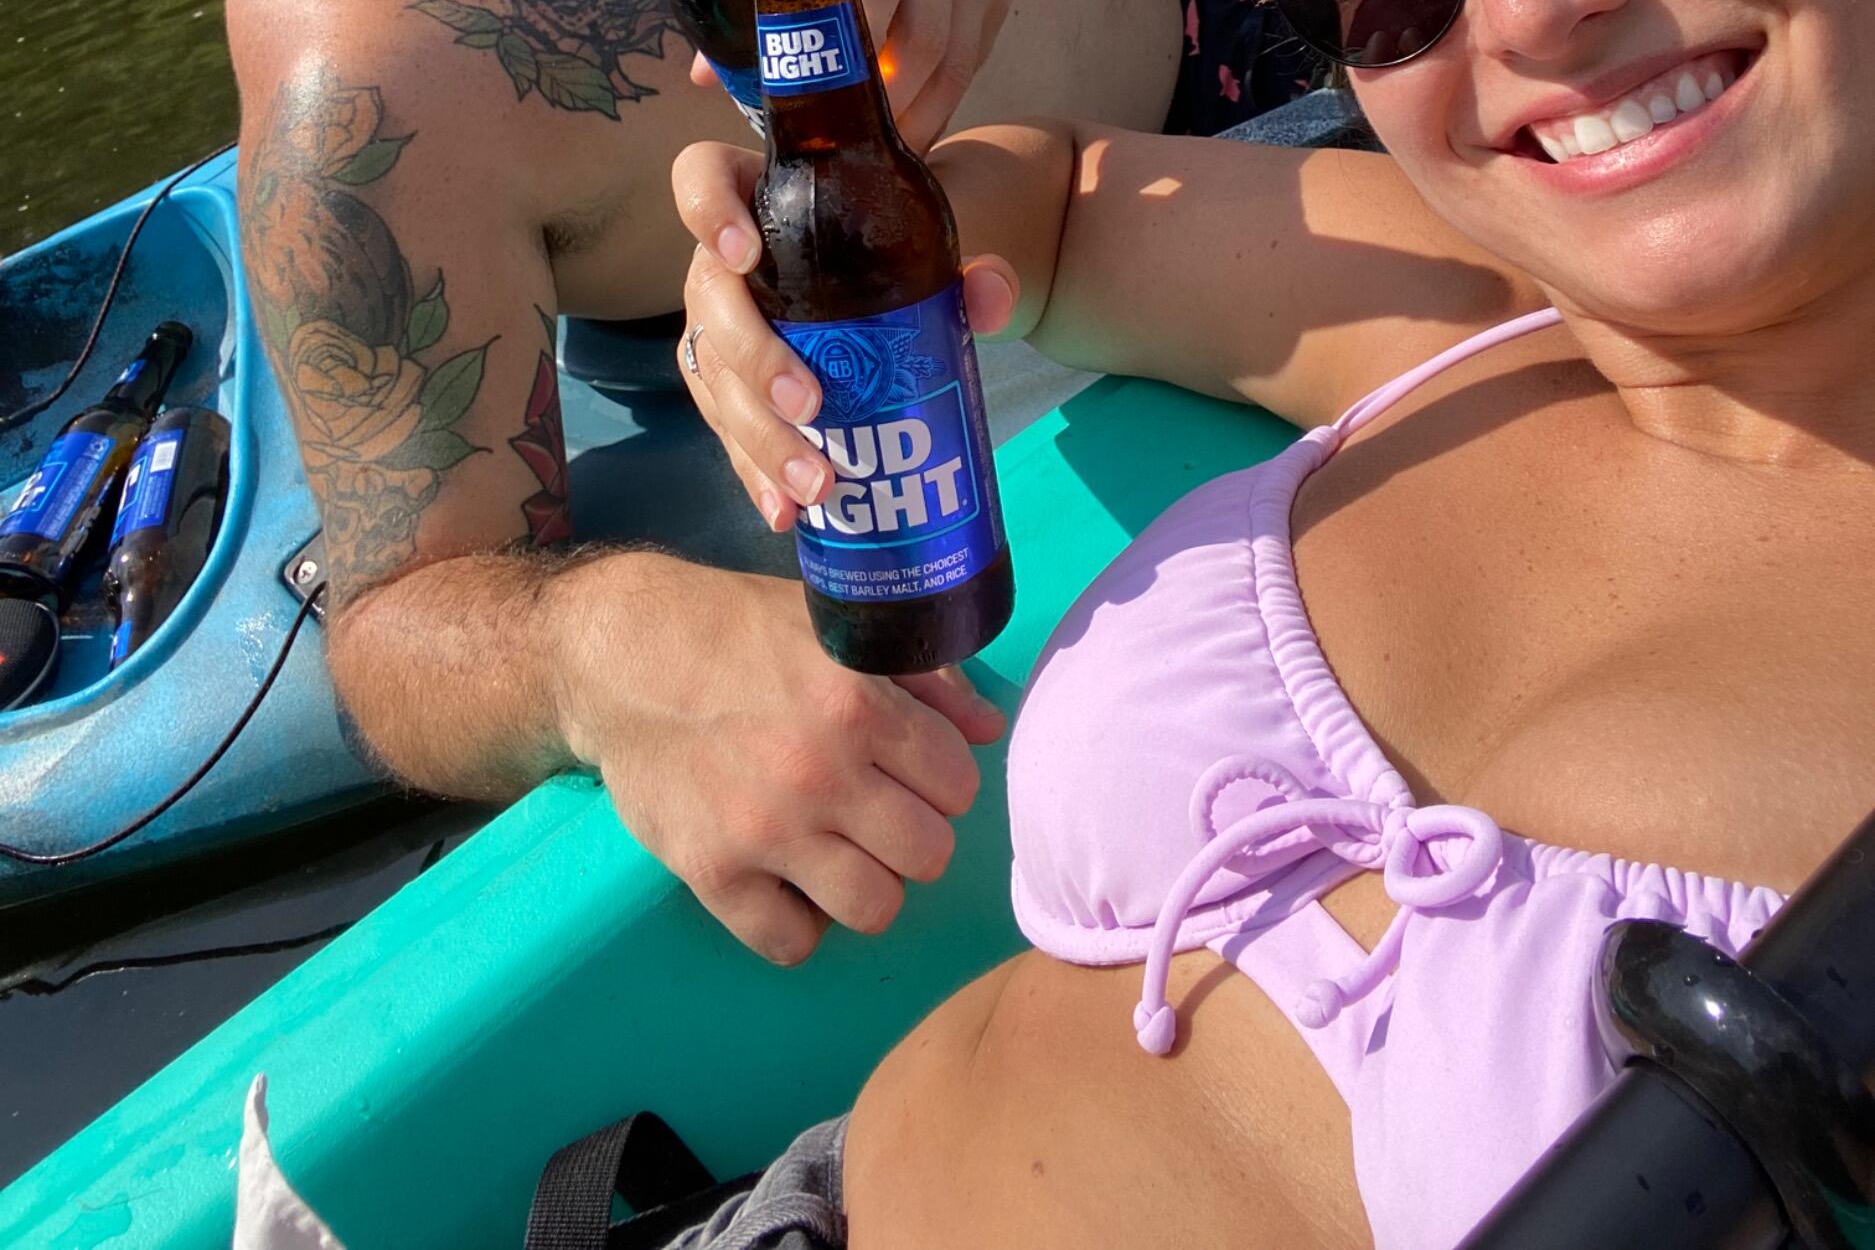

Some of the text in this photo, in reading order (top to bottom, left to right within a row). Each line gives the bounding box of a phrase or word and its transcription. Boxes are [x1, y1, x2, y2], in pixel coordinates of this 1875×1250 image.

[766, 29, 824, 56] BUD
[829, 567, 867, 582] BREWED
[868, 570, 900, 581] USING
[902, 566, 921, 578] THE
[923, 547, 969, 574] CHOICEST
[829, 581, 849, 595] BEST
[851, 585, 890, 596] BARLEY
[891, 581, 922, 594] MALT,
[923, 574, 945, 590] AND
[945, 564, 968, 581] RICE
